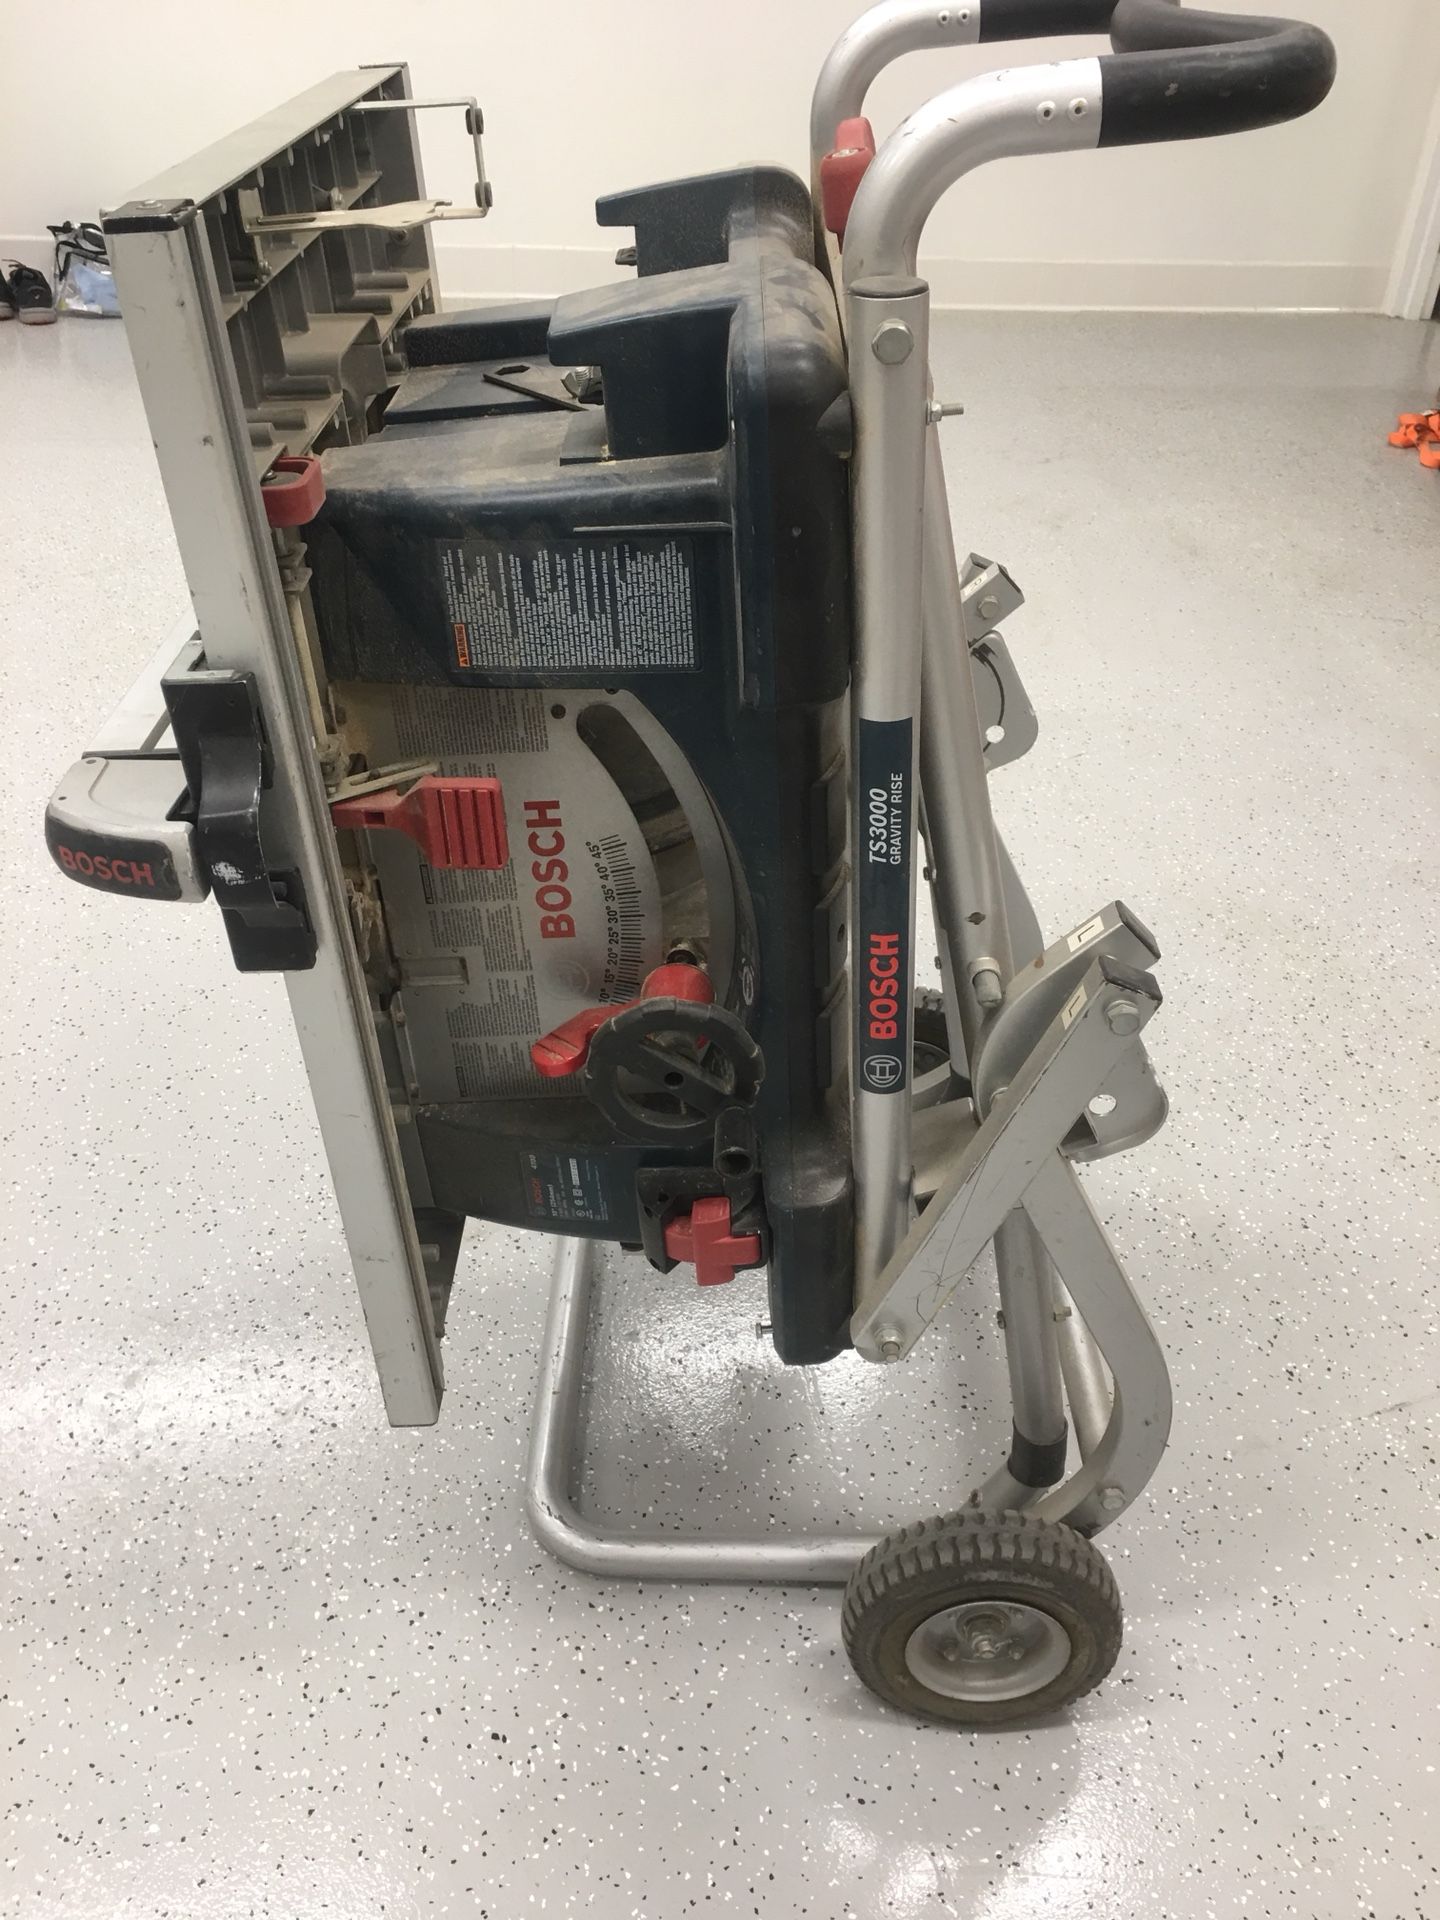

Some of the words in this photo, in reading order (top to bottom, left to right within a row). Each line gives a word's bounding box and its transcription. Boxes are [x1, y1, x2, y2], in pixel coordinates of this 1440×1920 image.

[890, 772, 903, 804] RISE
[869, 787, 888, 863] TS3000
[890, 807, 902, 865] GRAVITY
[585, 841, 601, 859] 45°
[58, 845, 155, 887] BOSCH
[524, 800, 576, 939] BOSCH
[594, 862, 610, 881] 40°
[601, 884, 616, 903] 35°
[605, 906, 618, 924] 30°
[607, 926, 619, 945] 25°
[606, 947, 618, 966] 20°
[604, 969, 615, 984] 15°
[869, 933, 899, 1039] BOSCH
